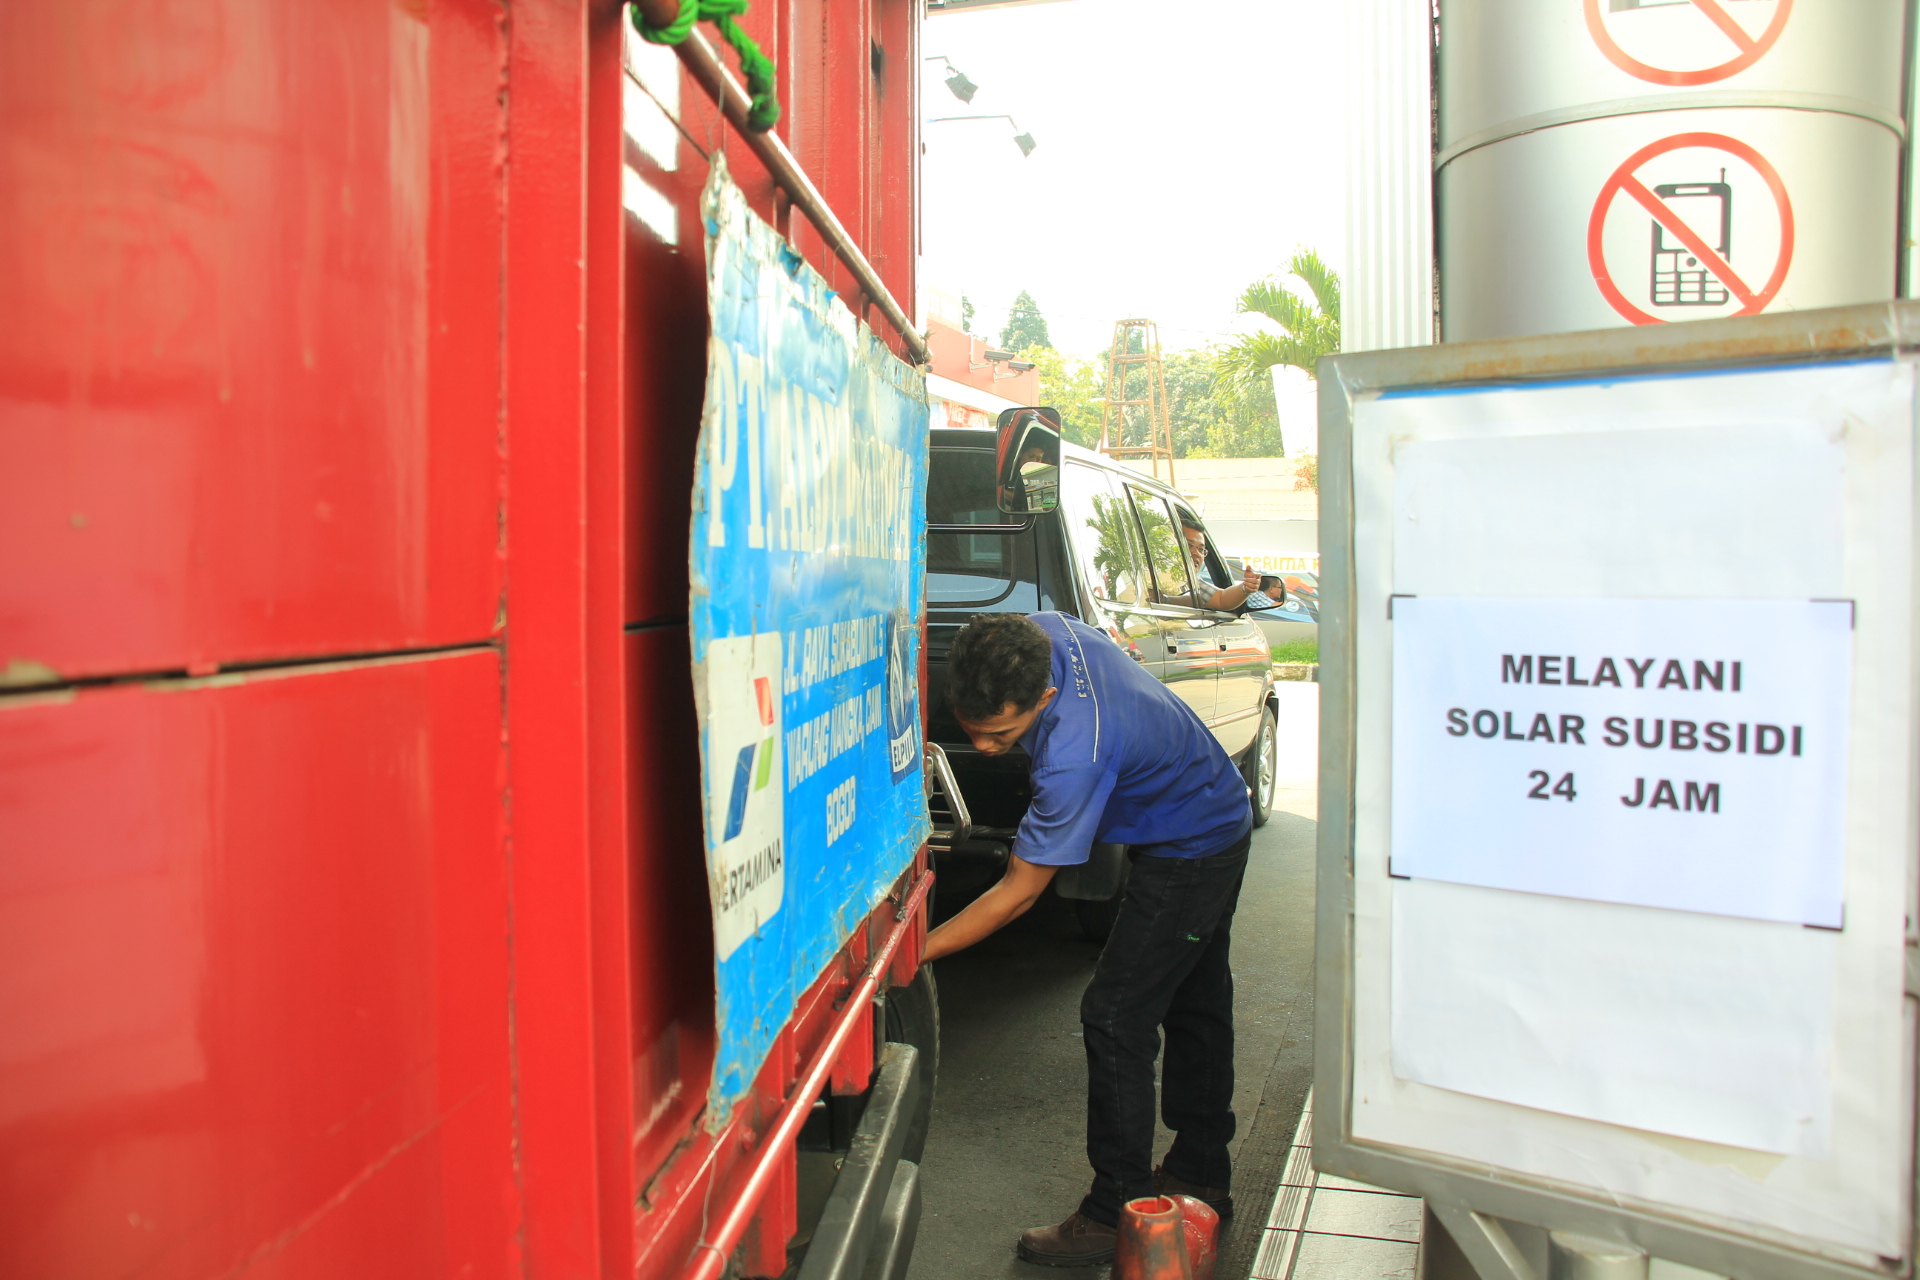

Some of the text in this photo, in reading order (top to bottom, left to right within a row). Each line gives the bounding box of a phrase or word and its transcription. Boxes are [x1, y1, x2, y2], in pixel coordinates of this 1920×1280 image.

[802, 625, 830, 689] RAYA
[831, 616, 868, 678] SUKABUMI
[1501, 653, 1742, 692] MELAYANI
[787, 711, 830, 793] WARUNG
[1446, 707, 1803, 757] SOLAR SUBSIDI
[826, 774, 857, 848] BOGOR
[1526, 770, 1721, 814] 24 JAM
